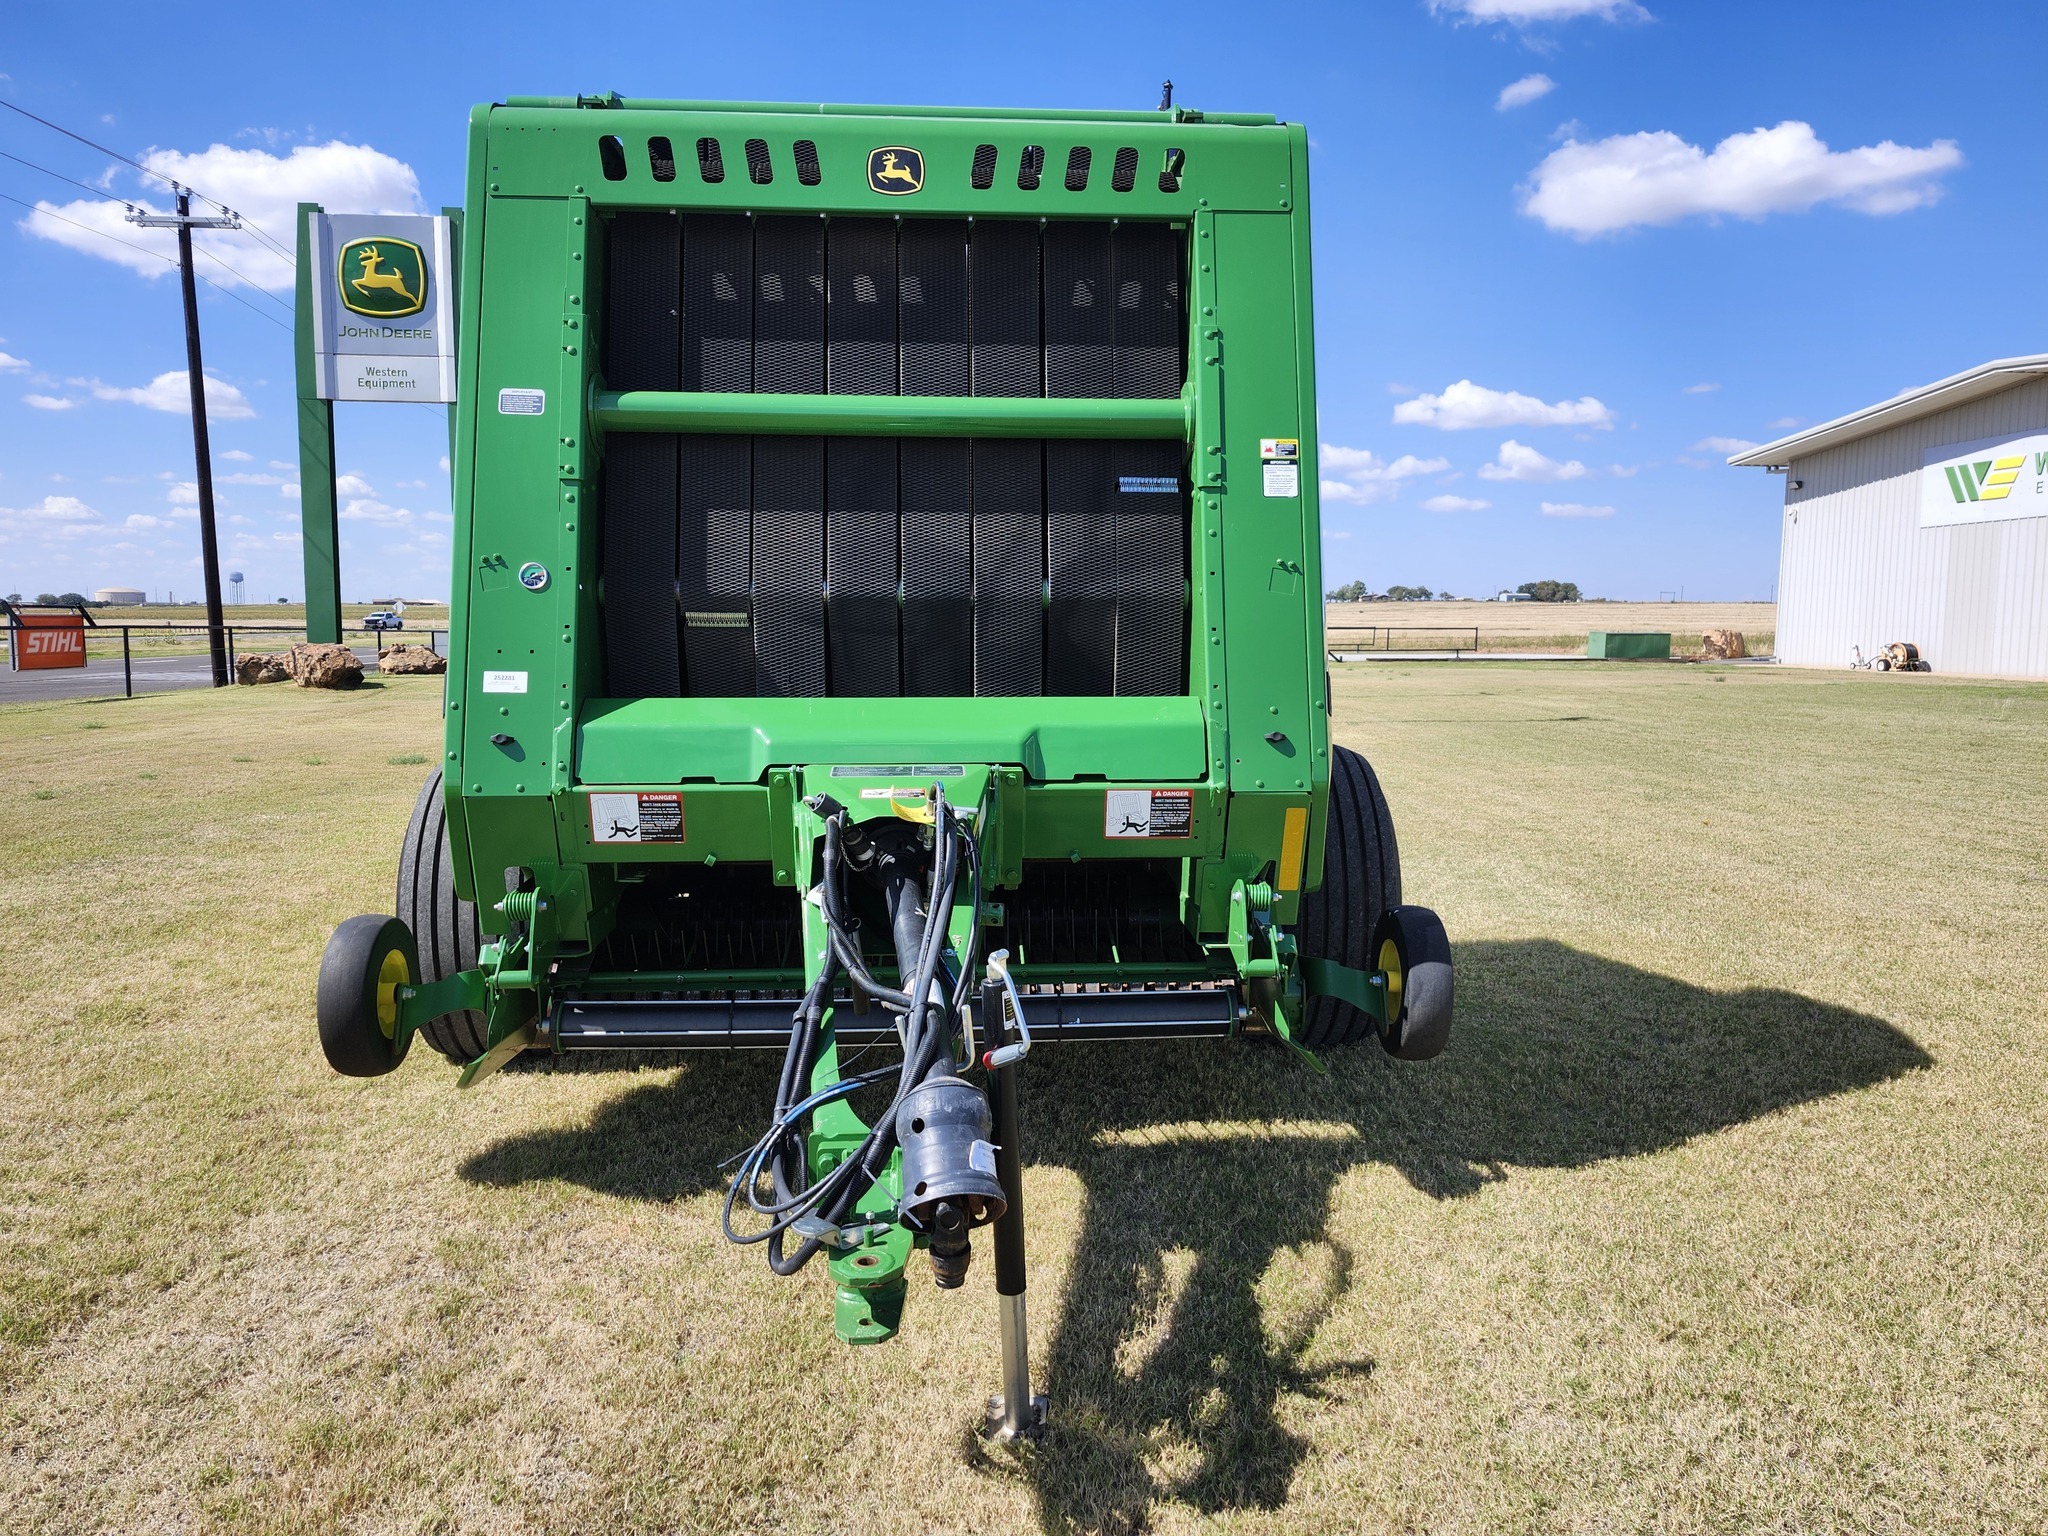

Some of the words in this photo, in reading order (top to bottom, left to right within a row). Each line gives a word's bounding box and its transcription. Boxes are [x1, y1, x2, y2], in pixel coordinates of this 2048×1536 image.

[365, 366, 408, 377] Western
[357, 377, 416, 390] Equipment
[26, 631, 82, 654] STIHL
